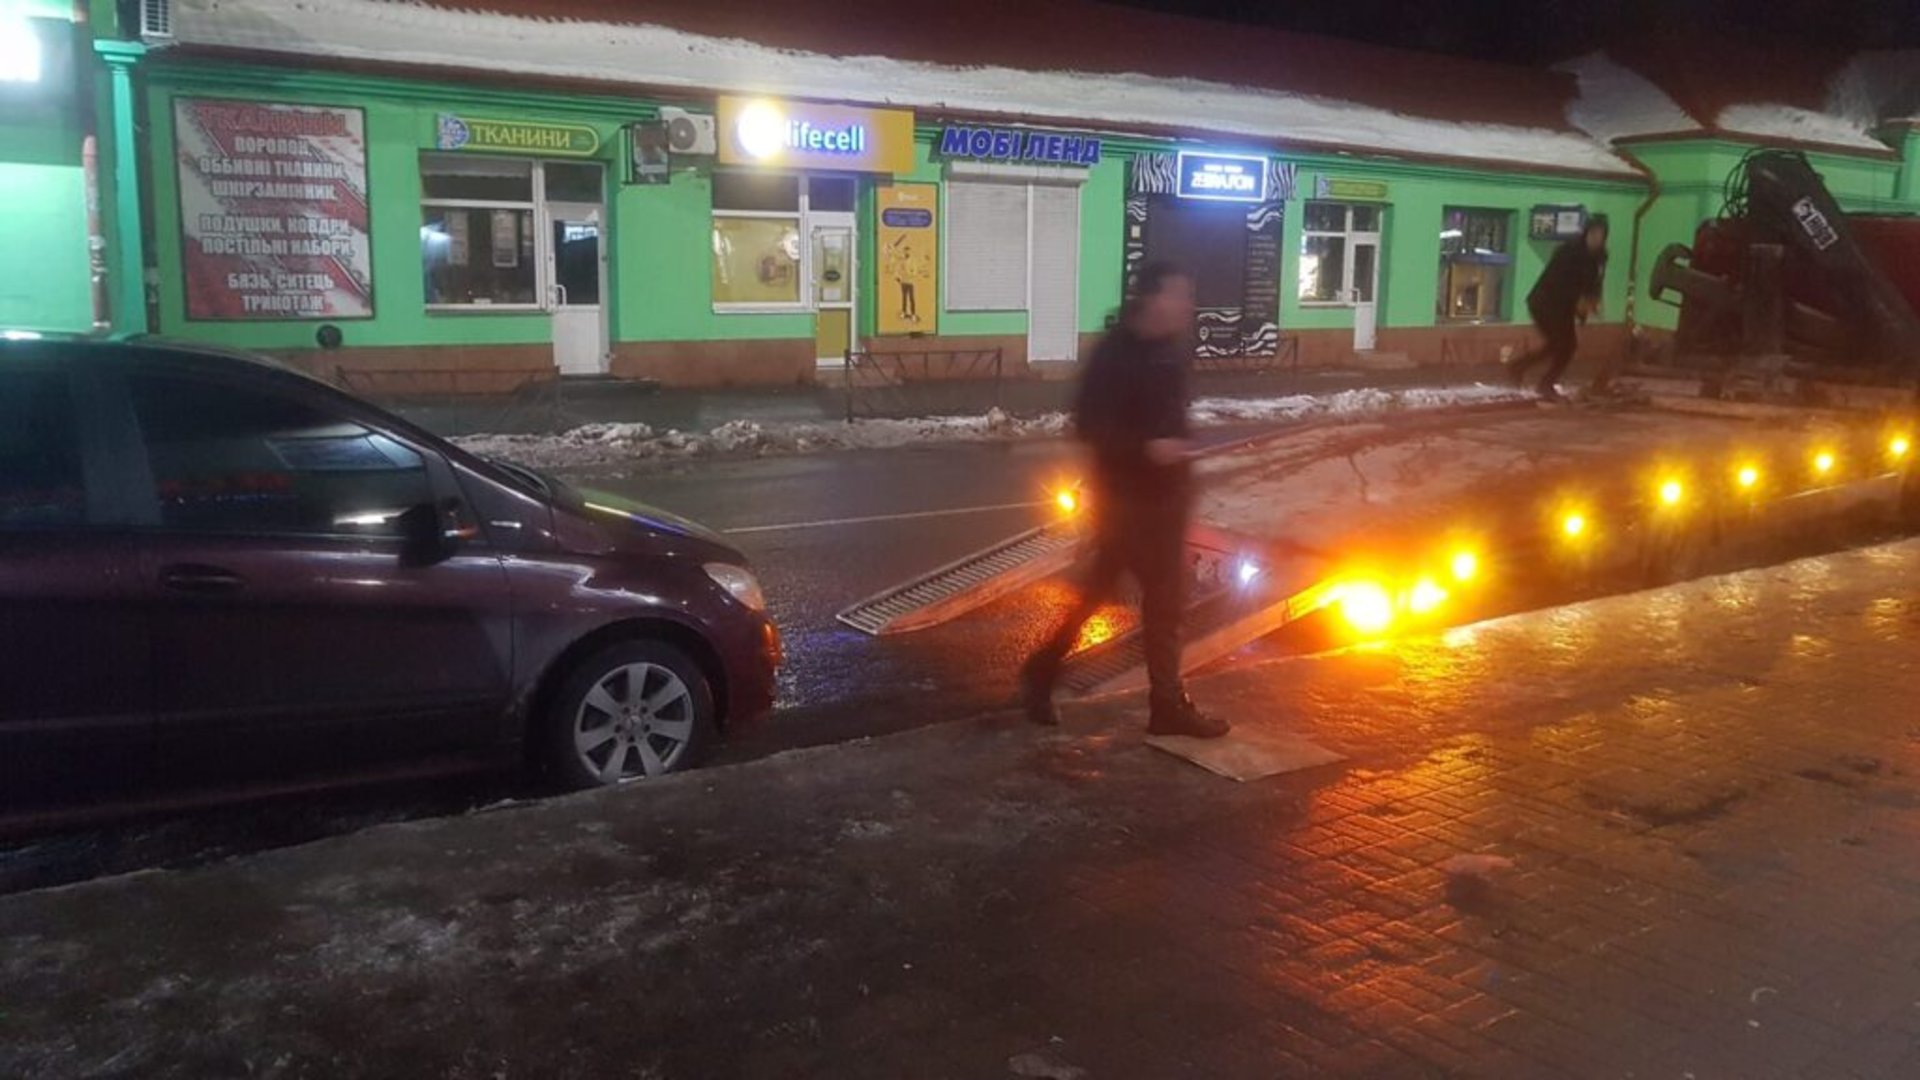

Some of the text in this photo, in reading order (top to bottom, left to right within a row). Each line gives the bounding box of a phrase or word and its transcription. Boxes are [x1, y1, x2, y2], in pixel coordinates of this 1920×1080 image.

[472, 124, 571, 148] ТКАНИНИ
[785, 119, 864, 151] lifecell
[939, 125, 1101, 165] МОБІ ЛЕНД
